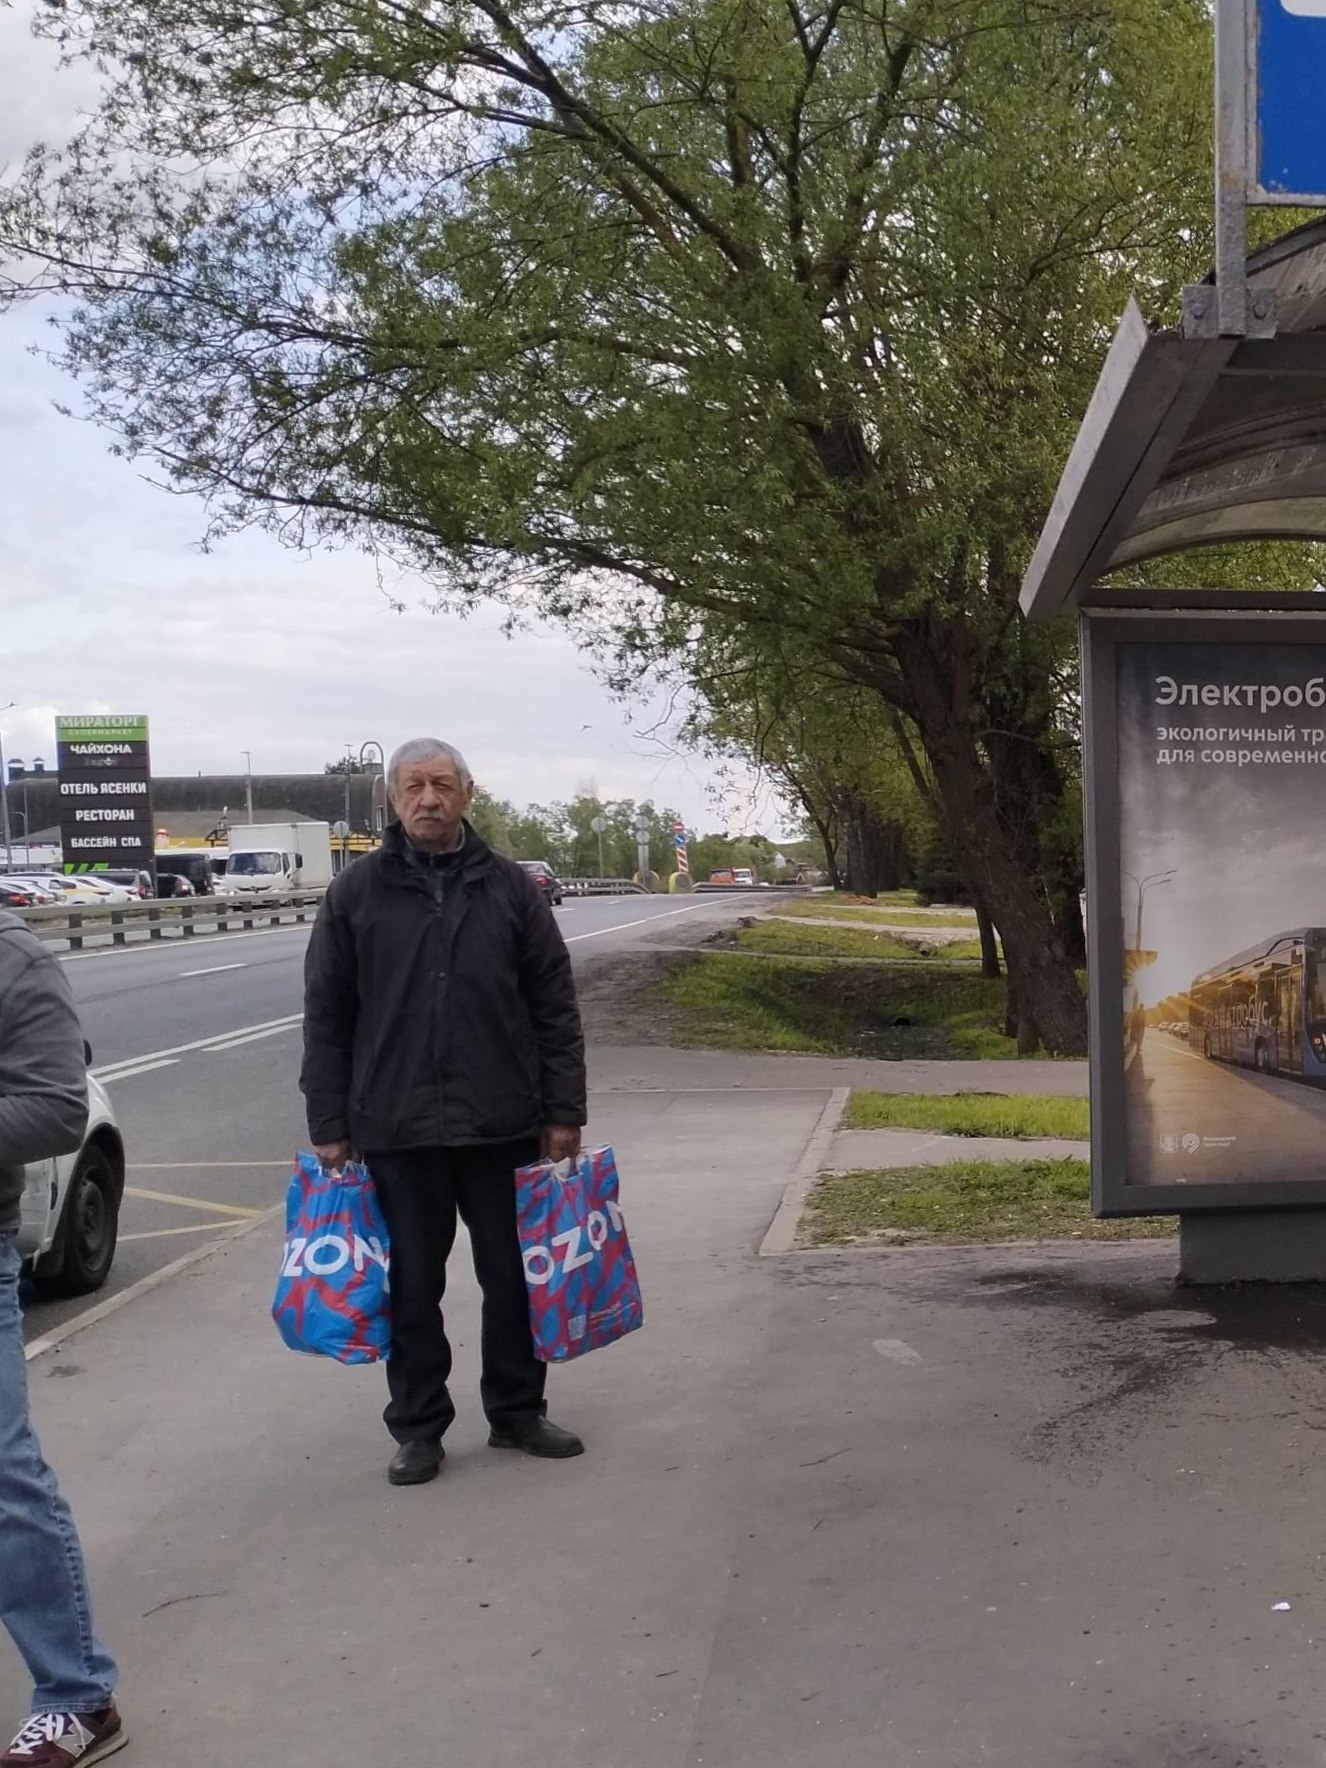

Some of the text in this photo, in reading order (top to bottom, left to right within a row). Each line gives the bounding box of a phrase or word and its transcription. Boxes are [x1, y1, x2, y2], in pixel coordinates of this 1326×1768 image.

[60, 716, 138, 728] МИРАТОРГ
[67, 728, 132, 736] СУПЕРМАРКЕТ
[1156, 724, 1296, 742] экологичный
[70, 743, 133, 754] ЧАЙХОНА
[1156, 748, 1195, 765] для
[60, 782, 147, 795] ОТЕЛЬ ЯСЕНКИ
[75, 809, 135, 821] РЕСТОРАН
[70, 836, 142, 848] БАССЕЙН СПА
[280, 1233, 390, 1277] ZON
